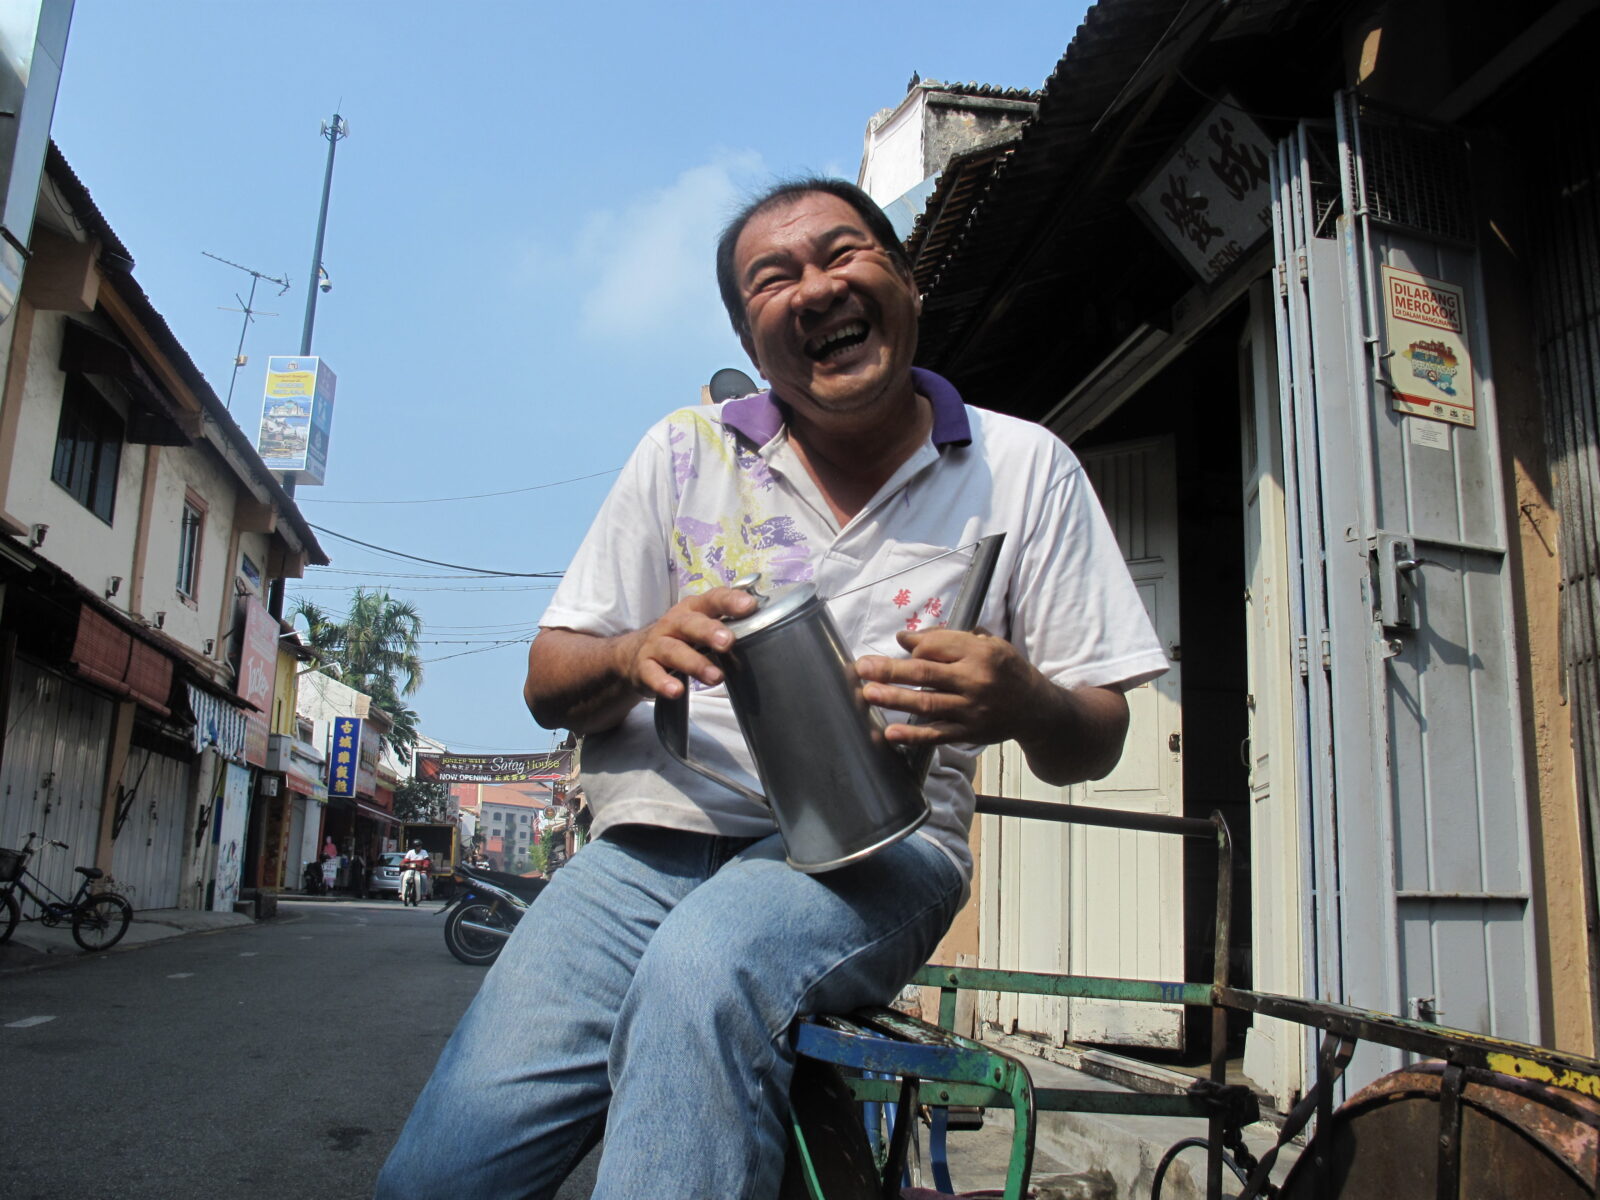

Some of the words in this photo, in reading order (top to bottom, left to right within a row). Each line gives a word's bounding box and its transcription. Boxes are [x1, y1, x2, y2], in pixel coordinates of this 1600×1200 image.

[1394, 283, 1455, 308] DILARANG
[1395, 296, 1457, 321] MEROKOK
[1403, 310, 1422, 320] DALAM
[490, 757, 525, 775] Satay
